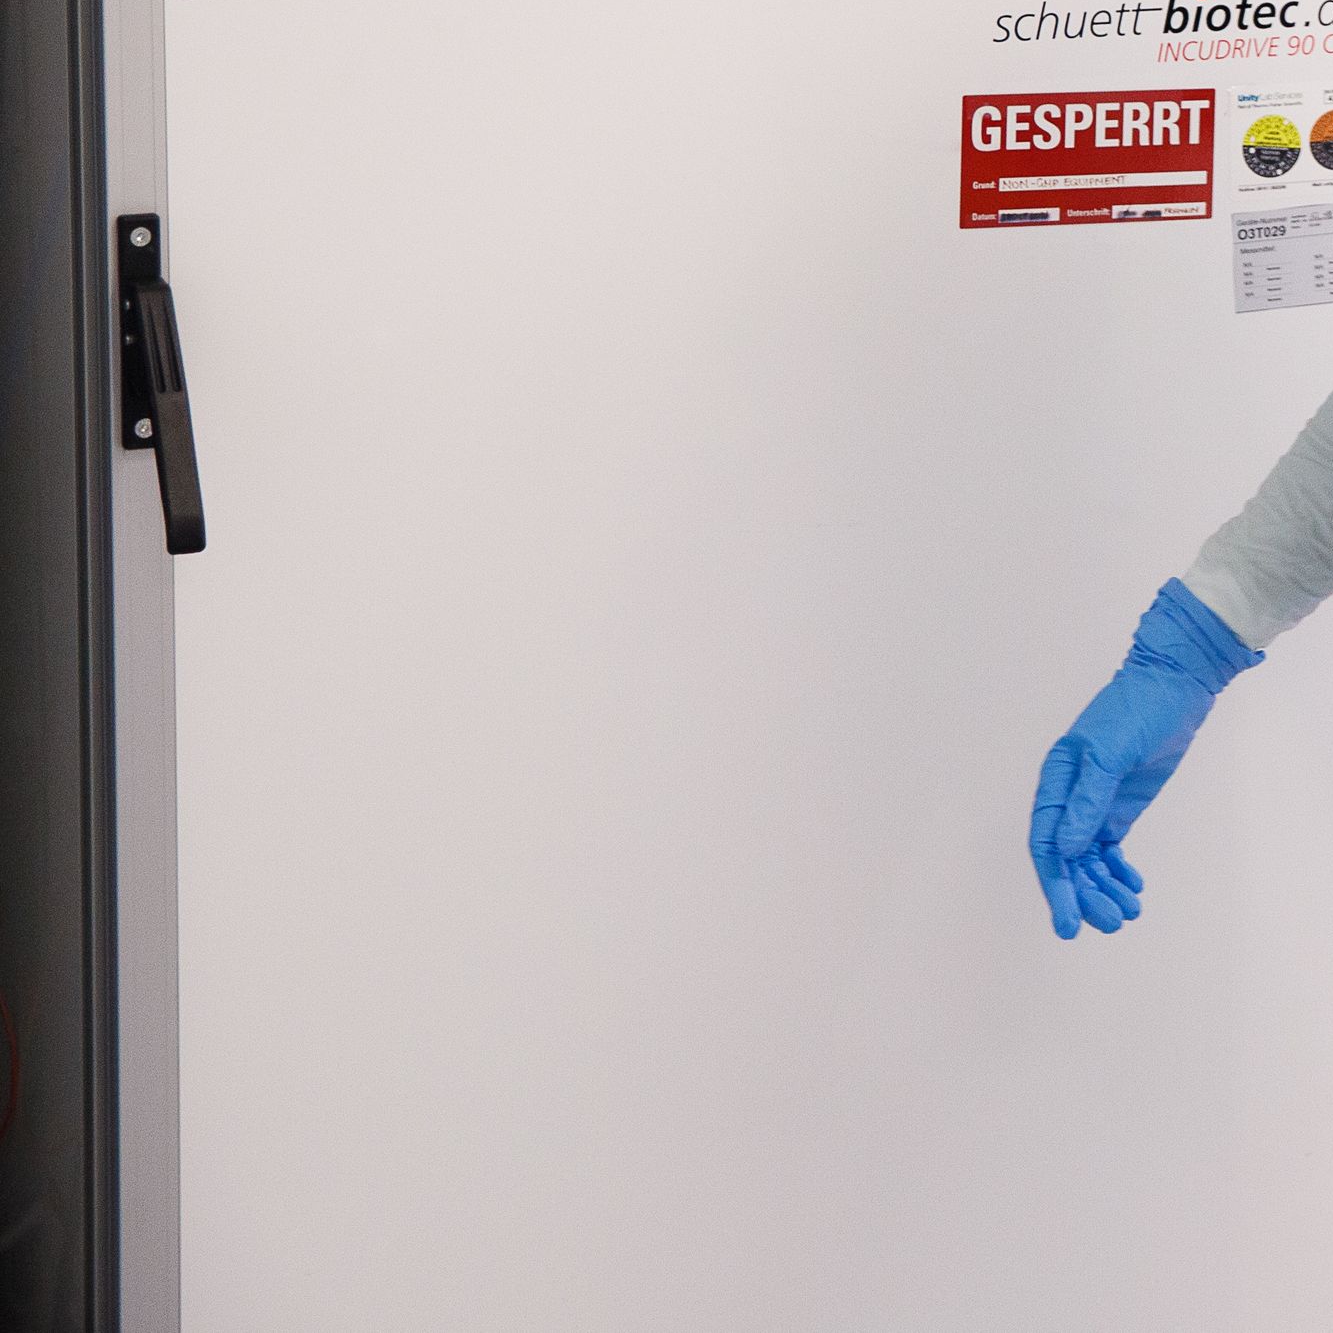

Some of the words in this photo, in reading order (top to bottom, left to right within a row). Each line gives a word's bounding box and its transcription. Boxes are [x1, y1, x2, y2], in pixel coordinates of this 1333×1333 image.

[1157, 36, 1280, 64] INCUDRIVE
[1287, 34, 1316, 56] 90
[971, 99, 1210, 153] GESPERRT
[972, 181, 996, 191] Grund:
[1063, 175, 1126, 187] EQUIPMENT
[972, 212, 996, 221] Datum:
